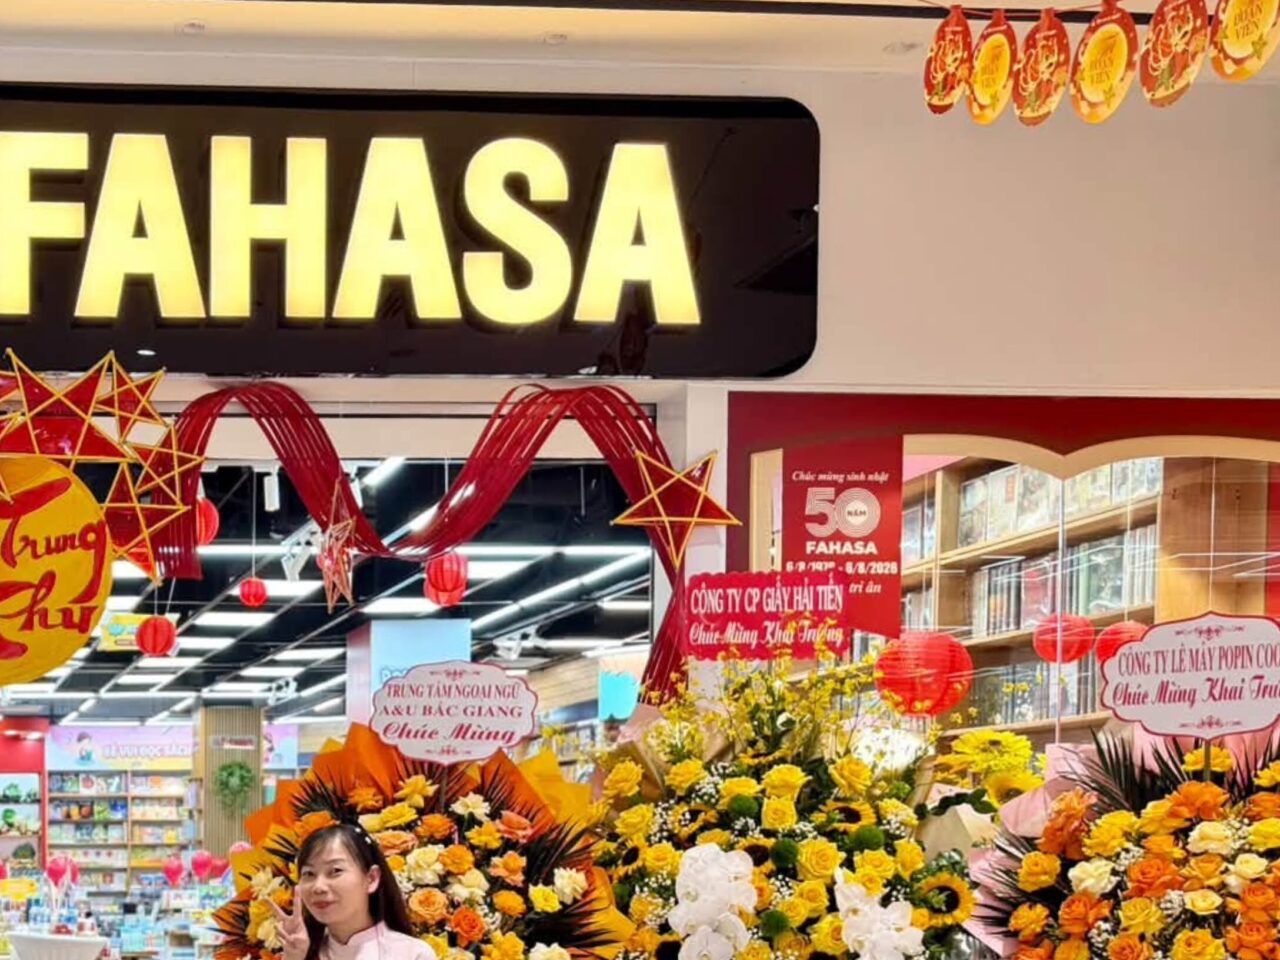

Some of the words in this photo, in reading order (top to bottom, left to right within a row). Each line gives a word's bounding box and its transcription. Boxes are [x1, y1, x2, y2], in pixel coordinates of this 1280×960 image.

[805, 487, 881, 538] 50
[805, 541, 878, 555] FAHASA
[690, 581, 724, 614] CÔNG
[726, 587, 743, 613] TY
[744, 587, 761, 613] CP
[794, 577, 814, 611] HẢI
[1118, 646, 1151, 677] CÔNG
[1154, 648, 1170, 675] TY
[1218, 643, 1255, 671] POPIN
[386, 683, 424, 699] TRUNG
[426, 680, 454, 698] TÂM
[455, 682, 492, 701] NGOẠI
[1112, 682, 1150, 707] Chúc
[1151, 680, 1197, 709] Mừng
[1201, 677, 1245, 703] Khai
[379, 704, 418, 718] A&U
[421, 702, 459, 718] BẮC
[462, 705, 523, 719] GIANG
[382, 721, 440, 741] Chúc
[443, 722, 516, 744] Mừng
